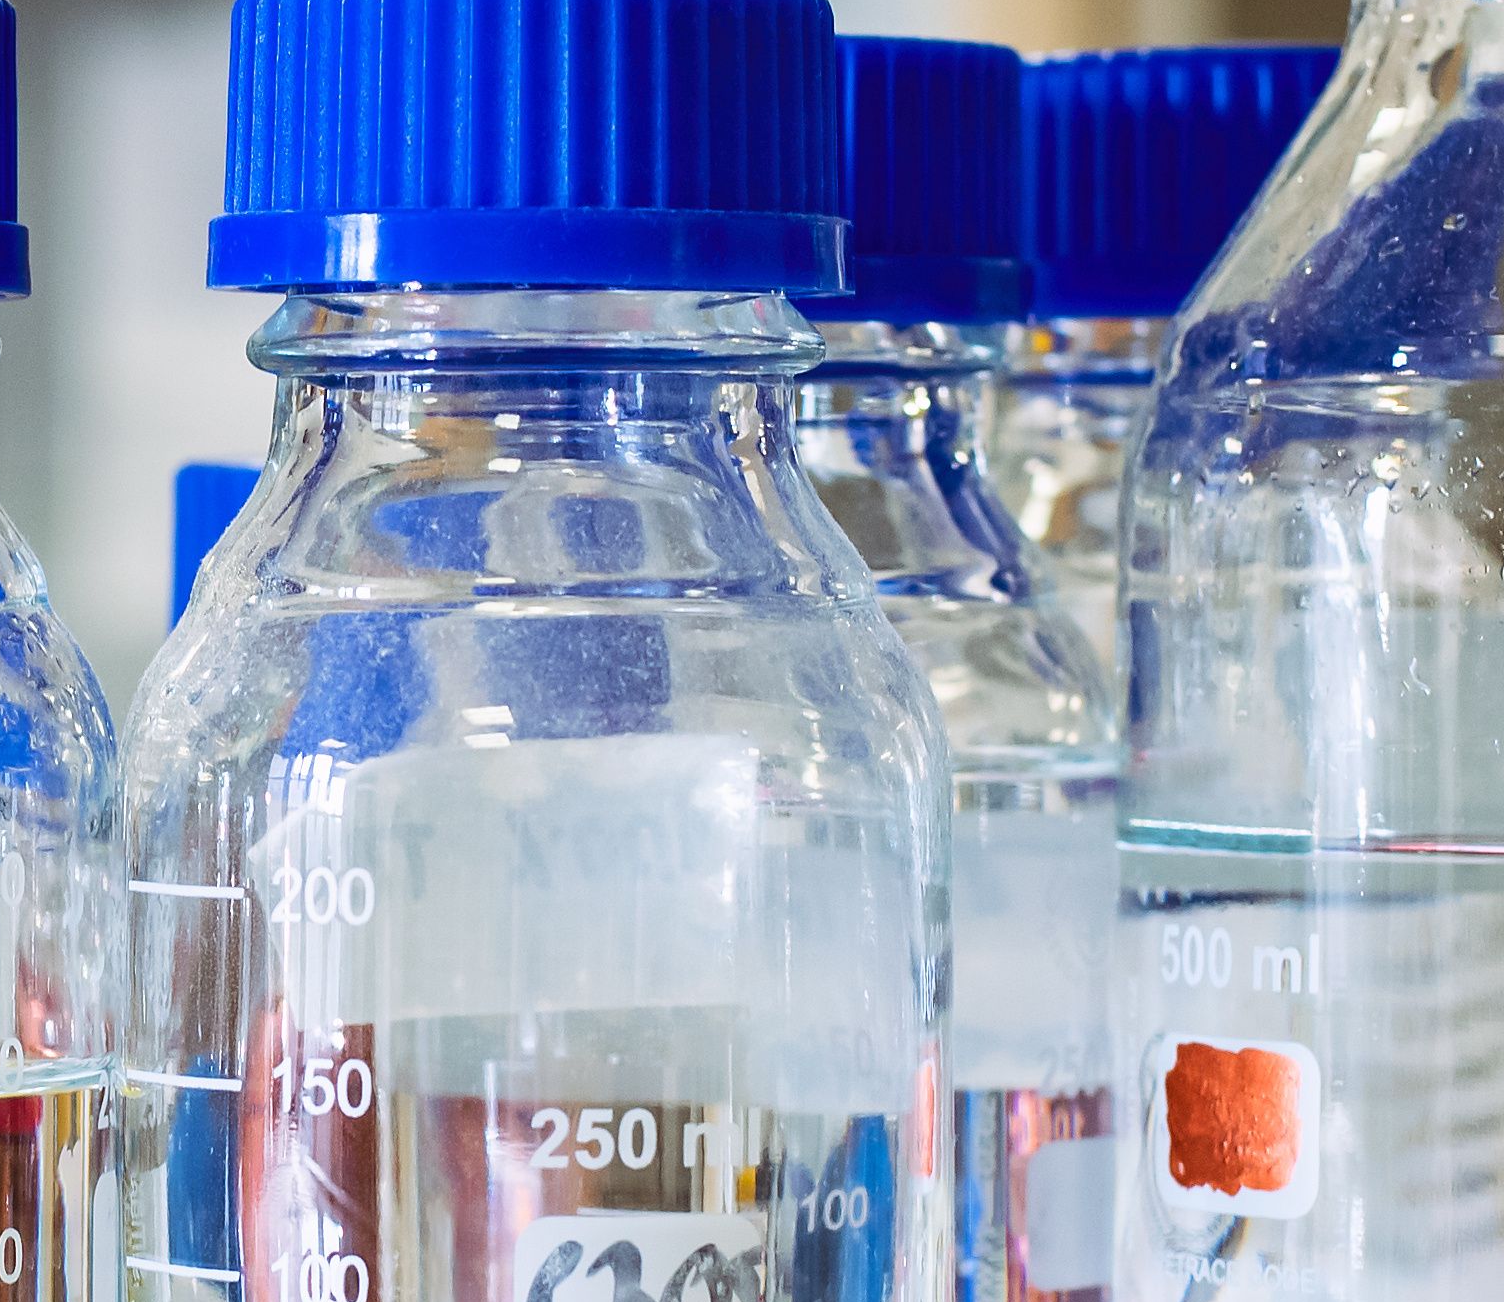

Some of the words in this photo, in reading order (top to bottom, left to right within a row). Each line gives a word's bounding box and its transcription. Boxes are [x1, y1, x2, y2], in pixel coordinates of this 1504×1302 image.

[270, 864, 376, 928] 200
[1160, 923, 1233, 989] 500
[1252, 932, 1320, 995] ml
[271, 1057, 374, 1120] 150
[528, 1107, 659, 1171] 250
[682, 1106, 762, 1169] ml
[798, 1186, 869, 1234] 100
